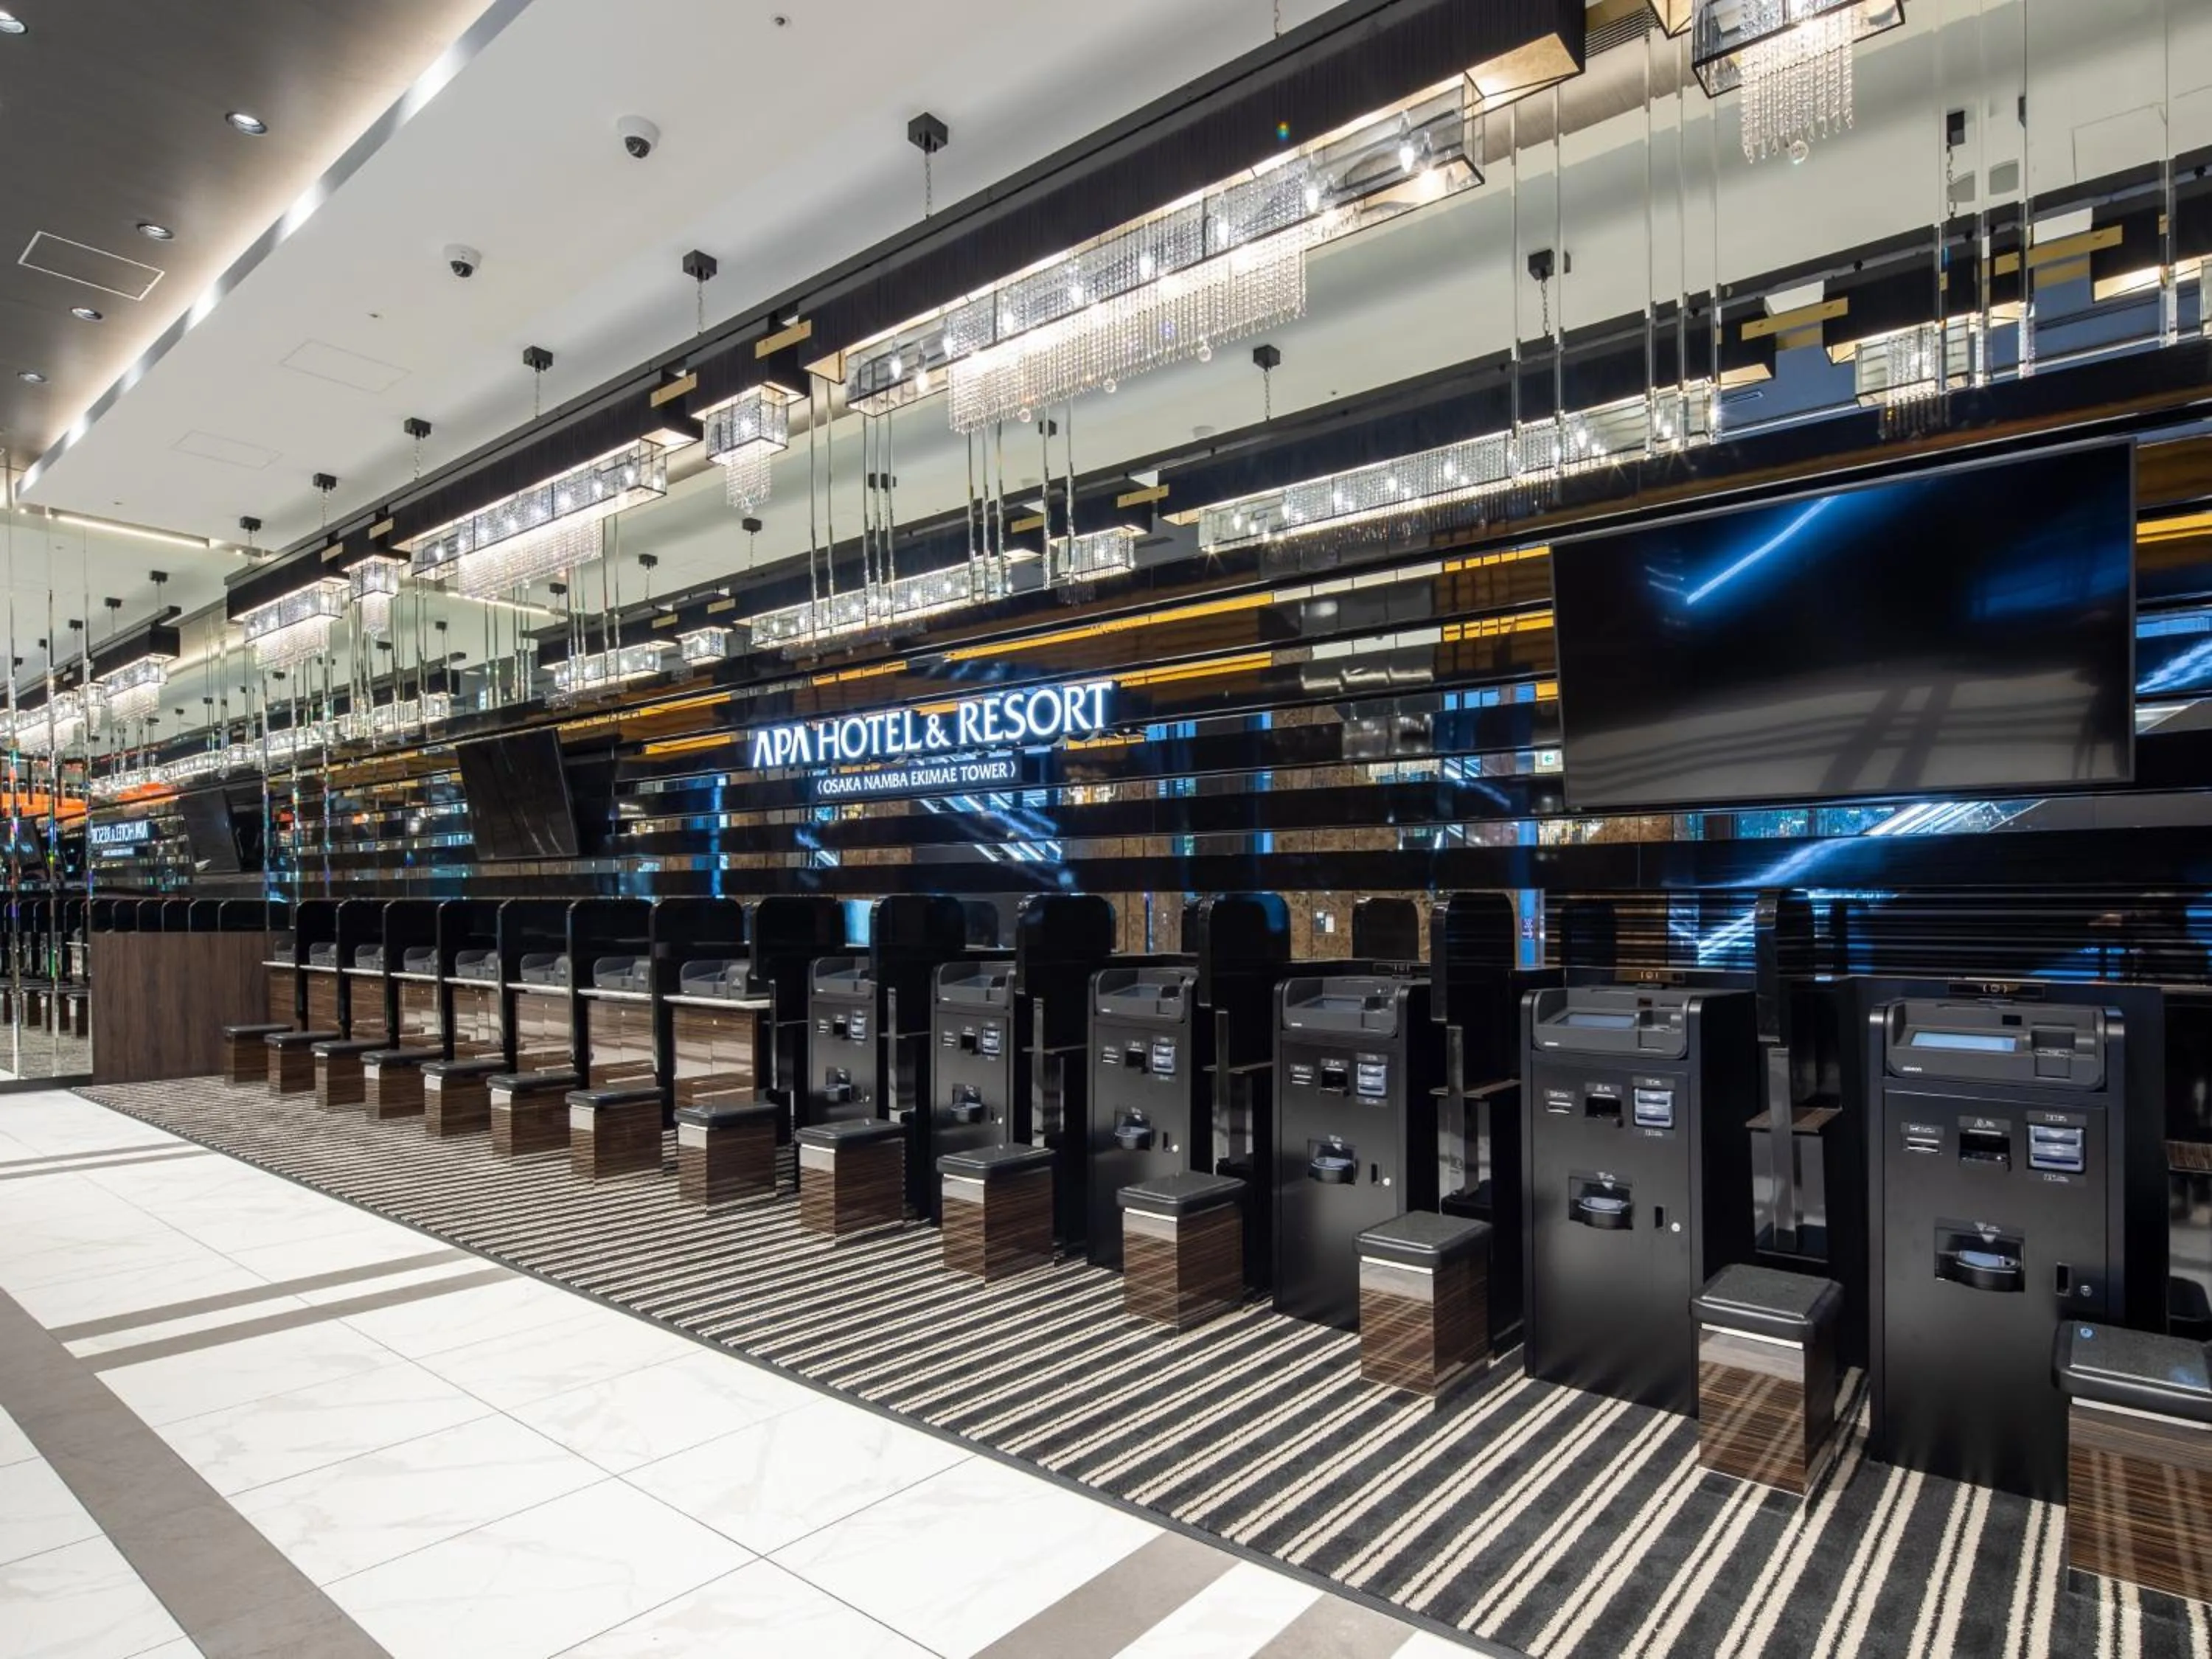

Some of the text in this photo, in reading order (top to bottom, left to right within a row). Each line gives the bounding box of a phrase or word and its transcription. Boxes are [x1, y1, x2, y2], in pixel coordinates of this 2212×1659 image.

[752, 681, 1113, 768] APA HOTEL & RESORT
[863, 771, 909, 791] NAMBA
[911, 766, 959, 787] EKIMAE
